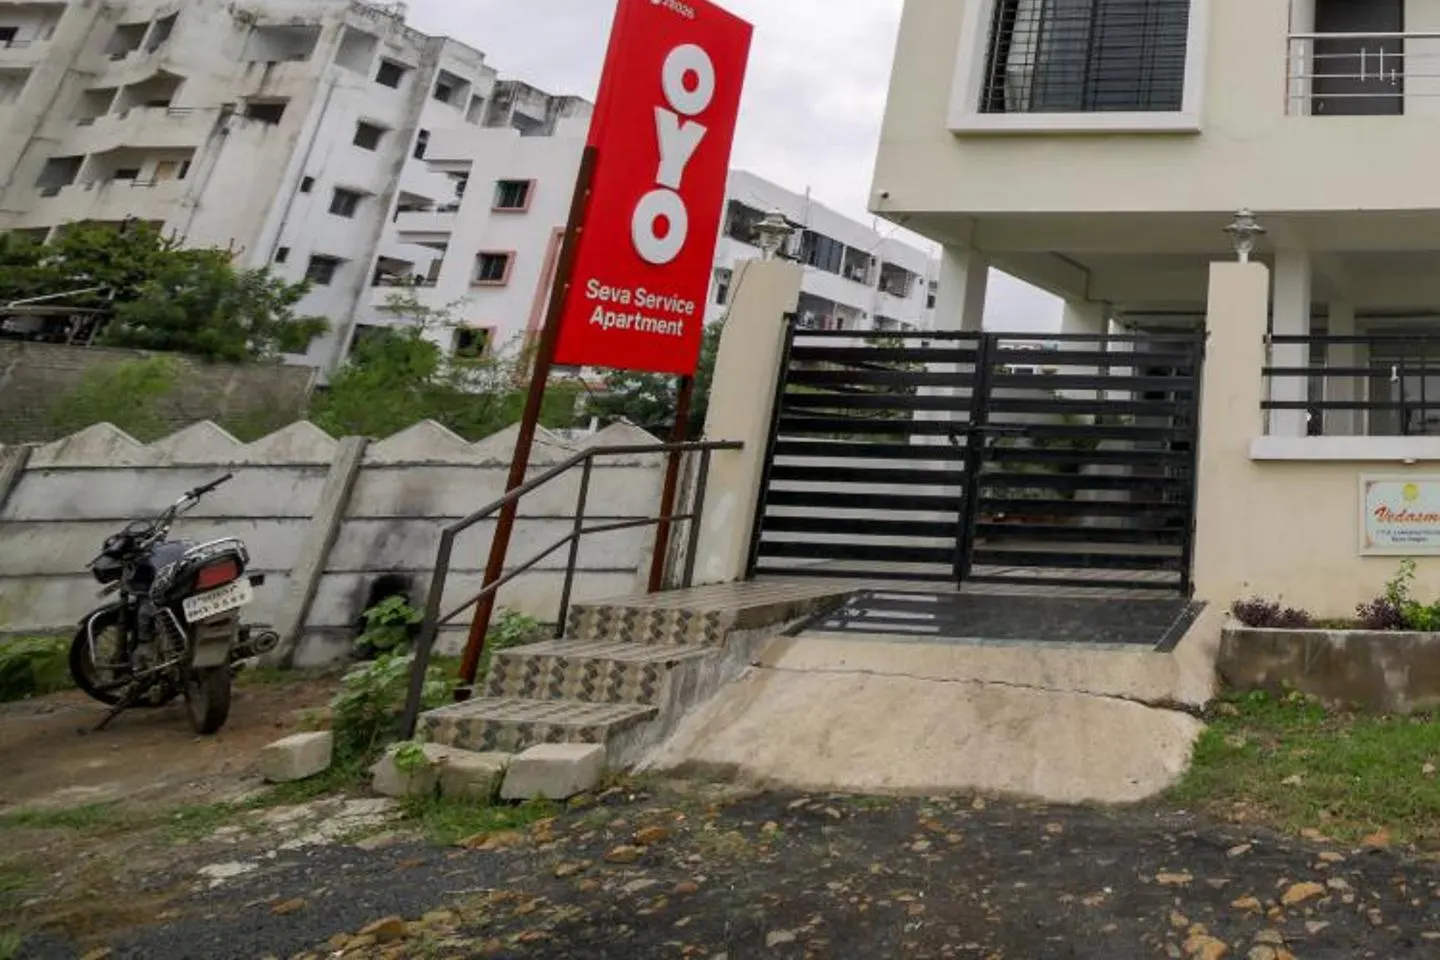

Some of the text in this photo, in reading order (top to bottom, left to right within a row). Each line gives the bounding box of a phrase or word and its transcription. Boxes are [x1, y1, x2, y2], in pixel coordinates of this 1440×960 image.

[631, 43, 716, 265] OYO
[586, 278, 695, 315] Seva Service
[589, 305, 684, 336] Apartment
